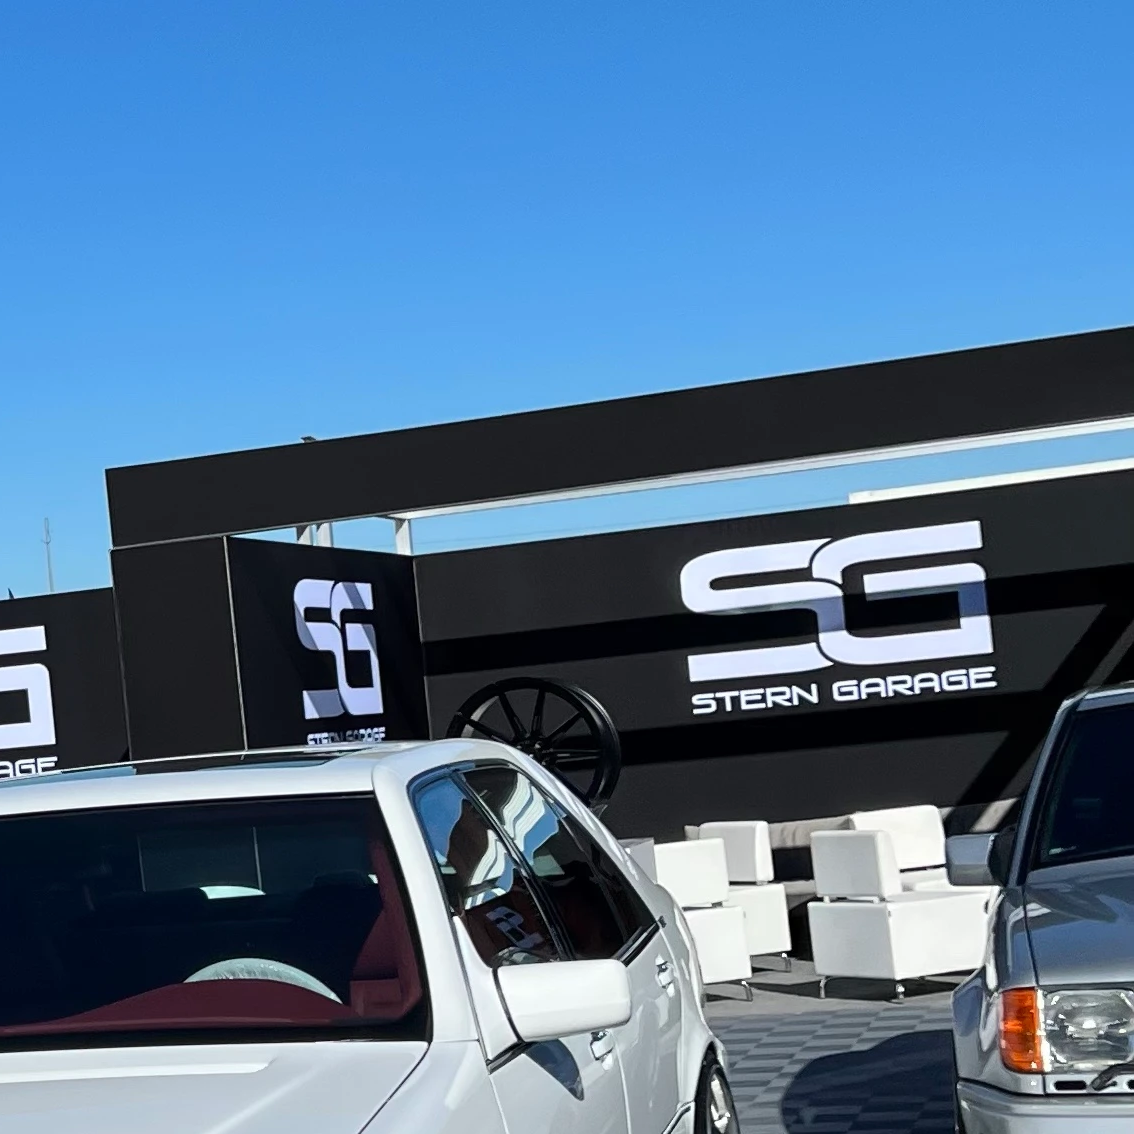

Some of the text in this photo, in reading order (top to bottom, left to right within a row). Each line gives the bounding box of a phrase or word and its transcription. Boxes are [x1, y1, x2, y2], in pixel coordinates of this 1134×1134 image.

[293, 578, 384, 720] SG
[680, 520, 994, 682] SG
[691, 666, 997, 714] STERN GARAGE
